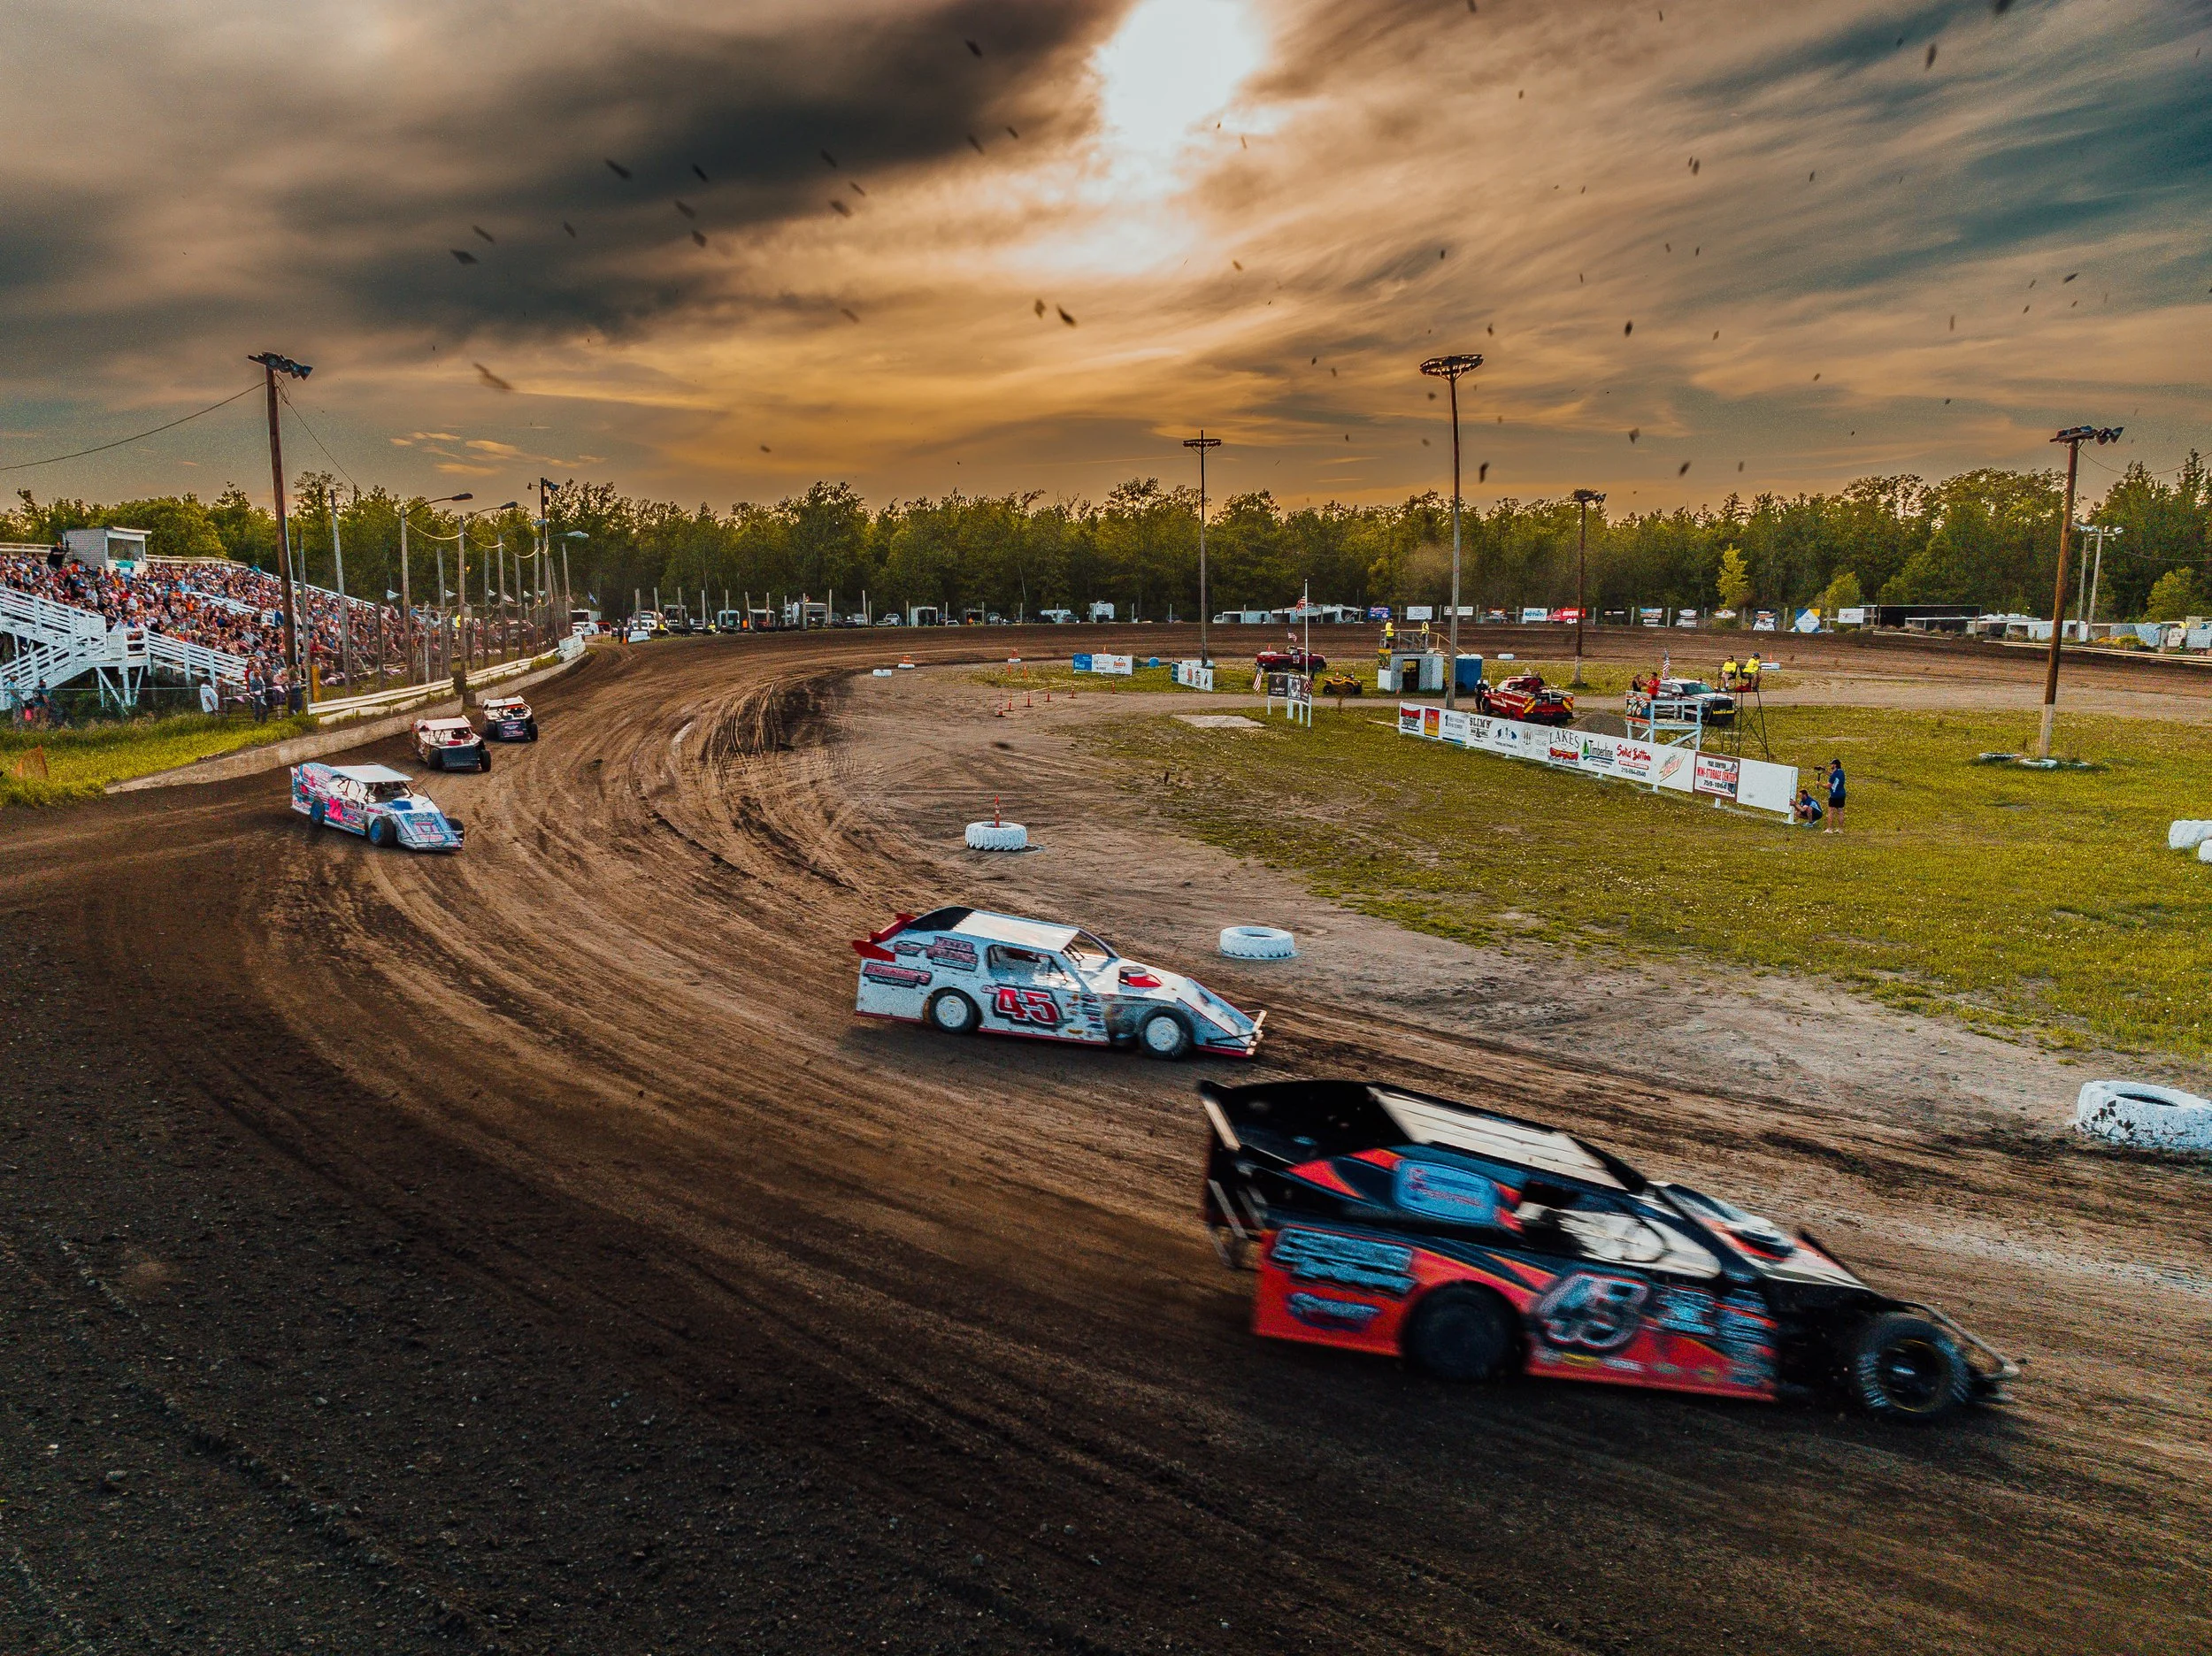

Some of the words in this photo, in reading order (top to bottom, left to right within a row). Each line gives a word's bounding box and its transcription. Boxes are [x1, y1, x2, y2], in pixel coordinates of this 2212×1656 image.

[1469, 717, 1491, 729] SLIM'S
[1549, 730, 1579, 748] LAKES
[1588, 740, 1613, 758] Timberline
[997, 986, 1060, 1025] 45
